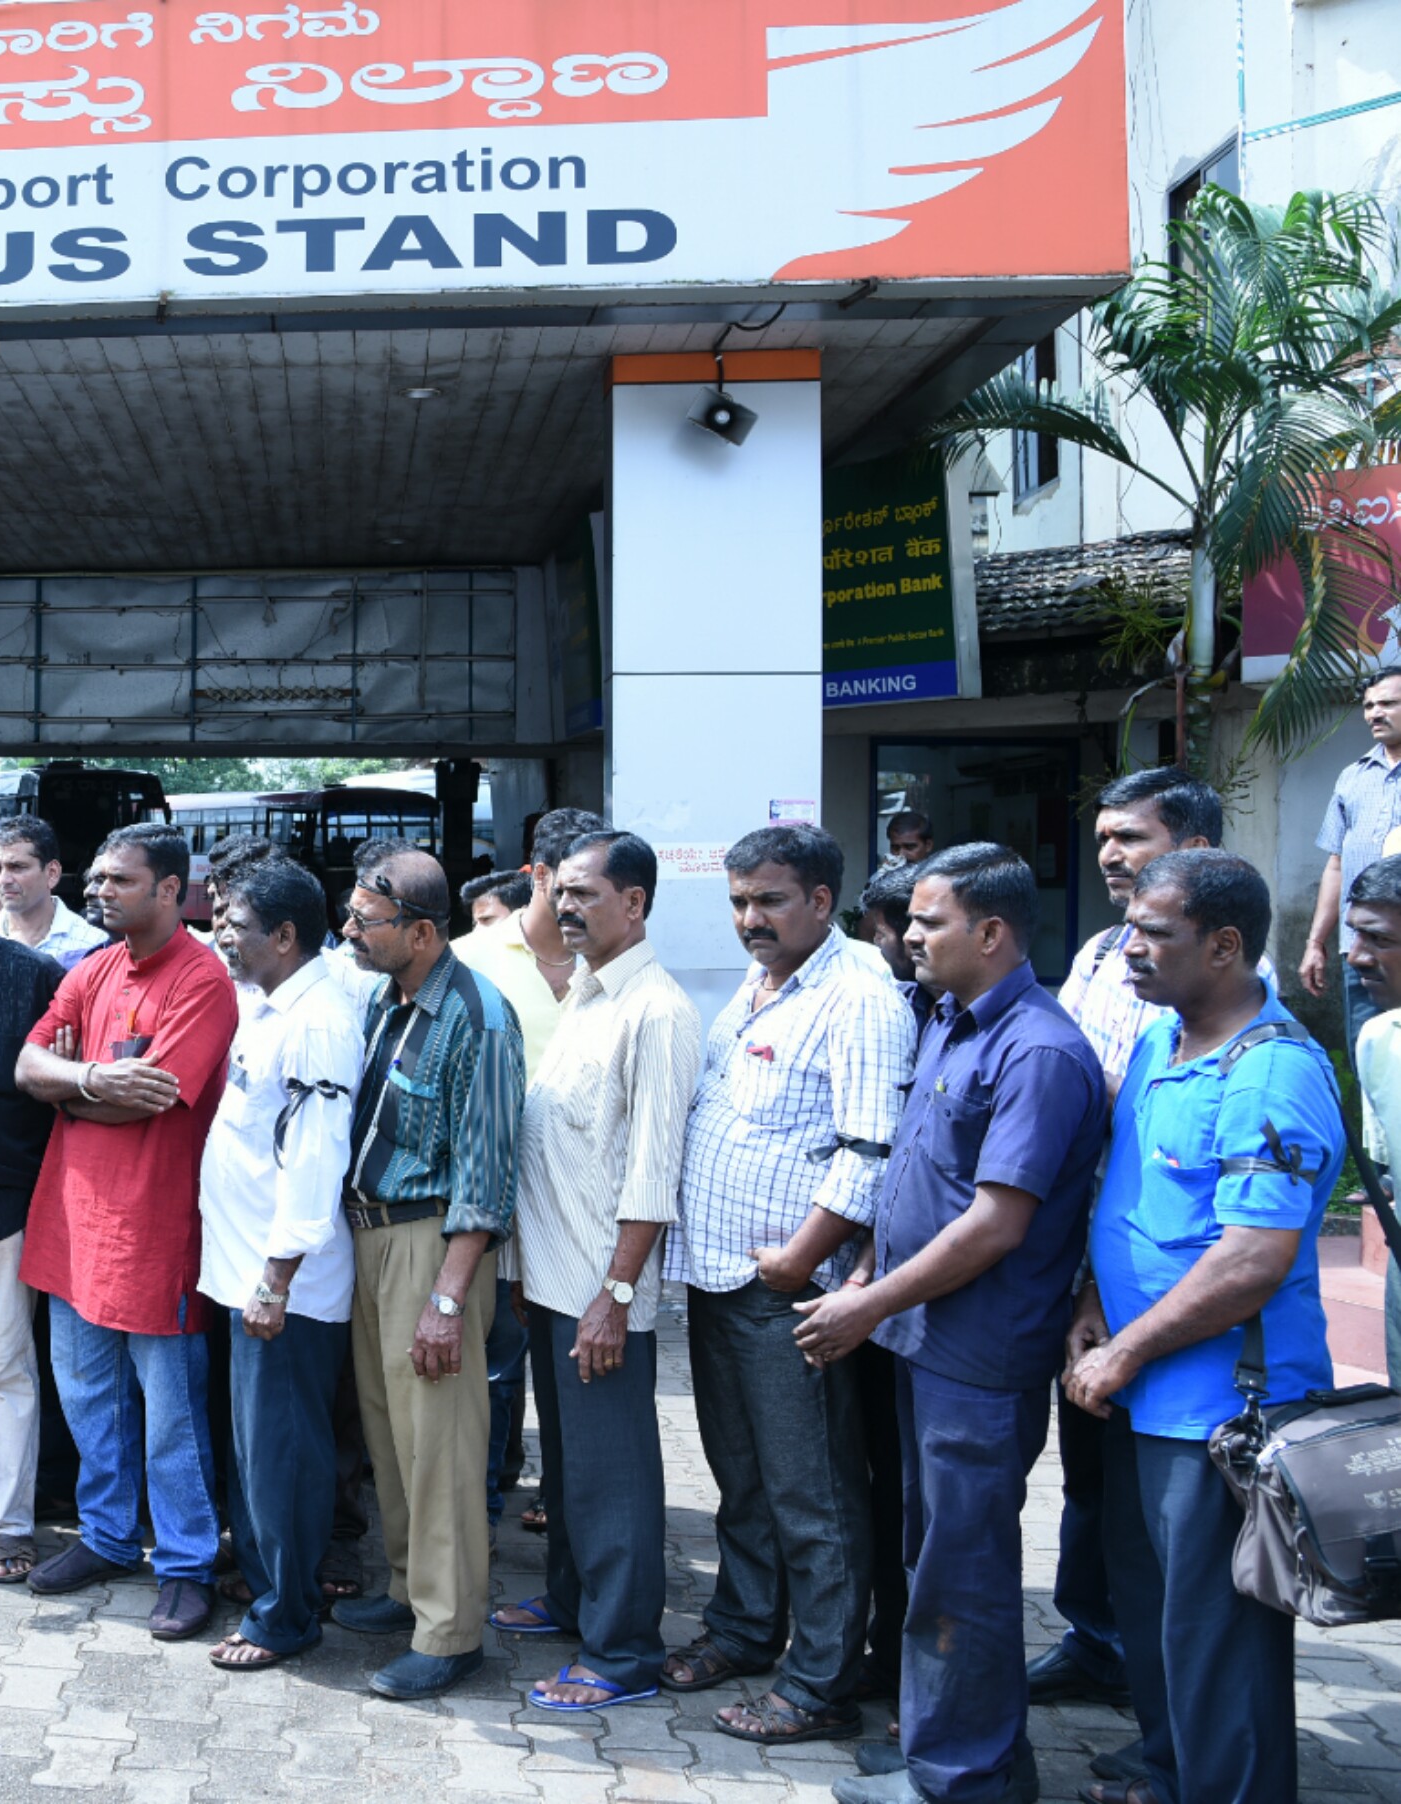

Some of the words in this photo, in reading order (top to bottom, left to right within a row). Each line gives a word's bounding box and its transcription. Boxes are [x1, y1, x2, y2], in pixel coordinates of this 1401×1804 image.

[189, 1, 380, 45] ನಿಗಮ
[231, 51, 669, 119] ನಿಲ್ದಾಣ
[165, 148, 586, 208] Corporation
[183, 208, 678, 276] STAND
[823, 580, 896, 608] rporation
[900, 572, 943, 595] Bank
[826, 675, 917, 698] BANKING
